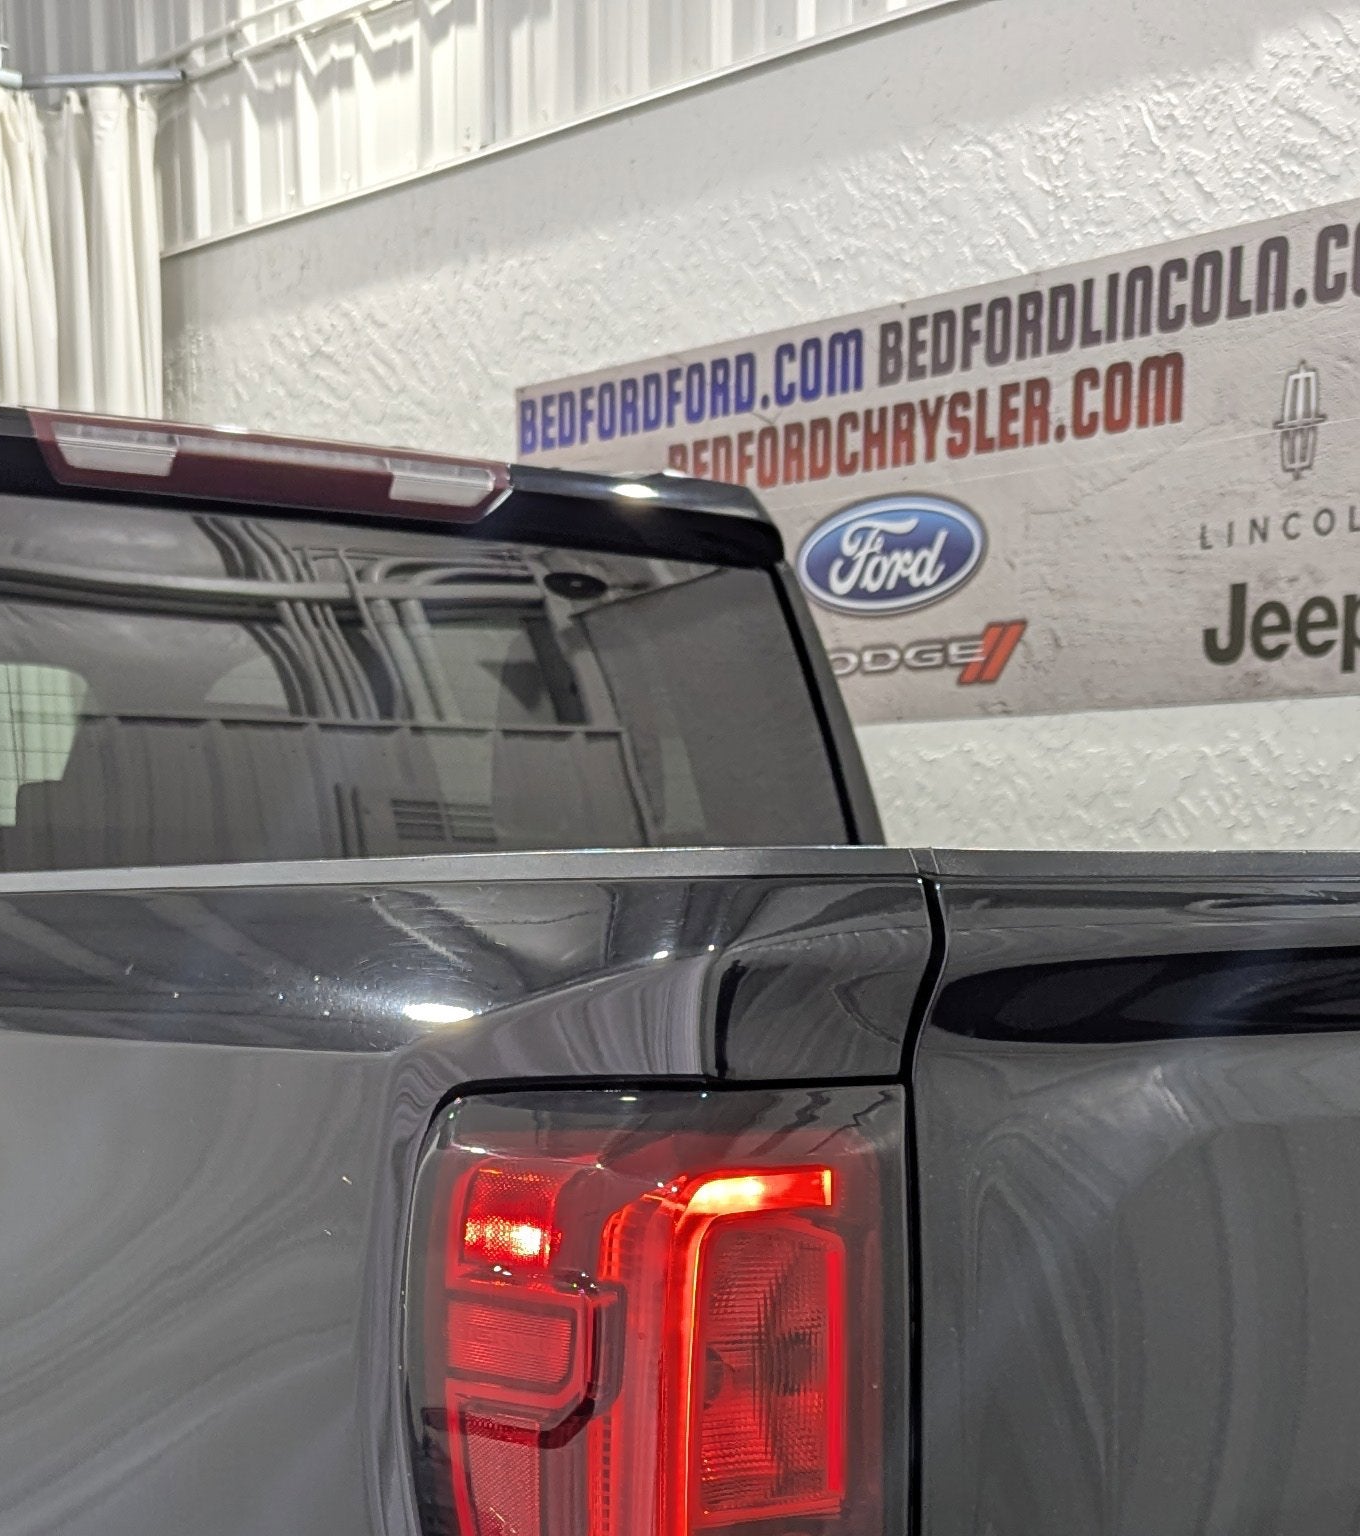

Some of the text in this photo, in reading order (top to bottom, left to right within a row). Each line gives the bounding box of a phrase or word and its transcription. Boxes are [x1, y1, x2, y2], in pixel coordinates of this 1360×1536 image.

[519, 328, 864, 453] BEDFORDFORD.COM
[828, 519, 947, 594] Ford
[826, 634, 987, 678] ODGE
